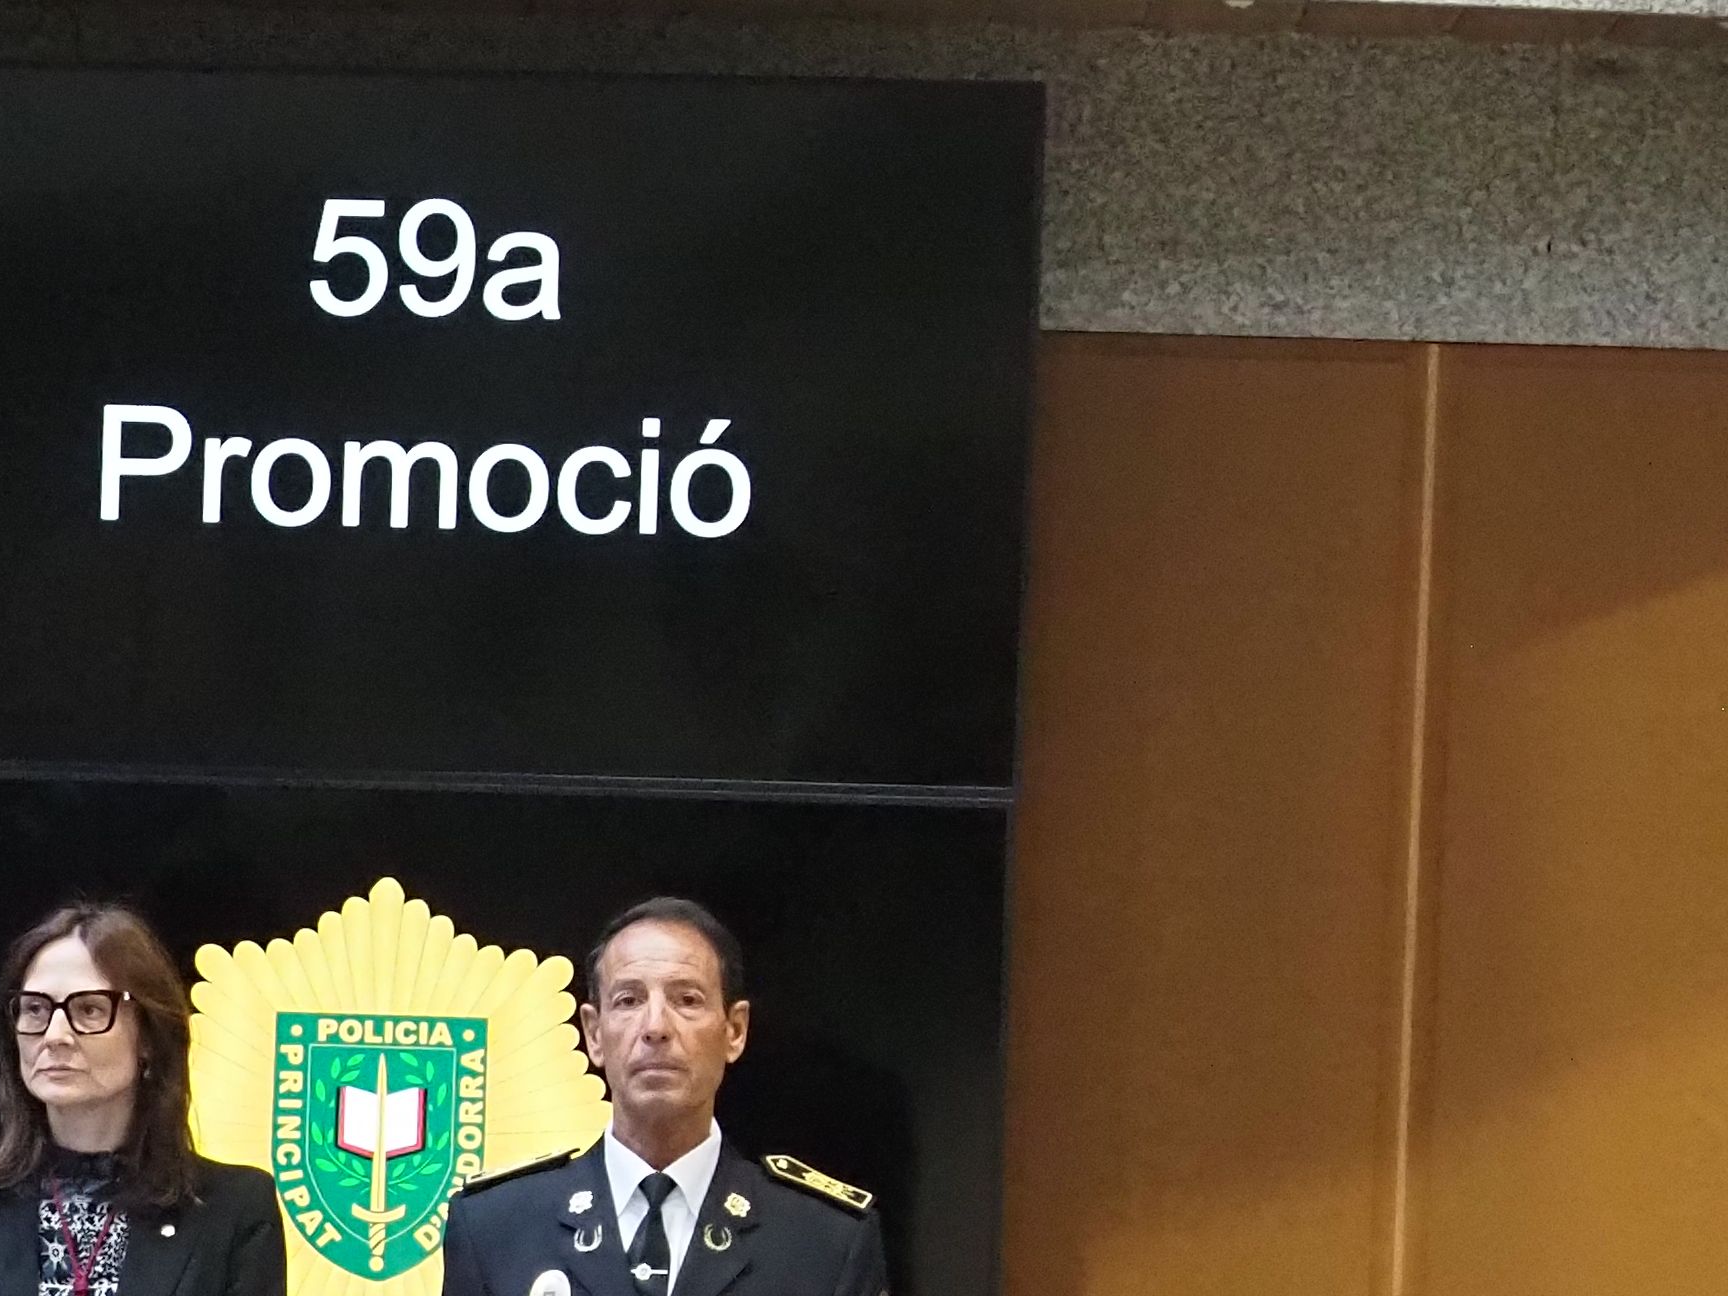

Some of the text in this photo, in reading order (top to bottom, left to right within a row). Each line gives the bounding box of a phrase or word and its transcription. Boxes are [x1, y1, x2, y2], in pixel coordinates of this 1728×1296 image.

[308, 197, 562, 321] 59a
[99, 403, 752, 539] Promoció
[317, 1018, 454, 1046] POLICIA
[276, 1044, 342, 1248] PRINCIPAT
